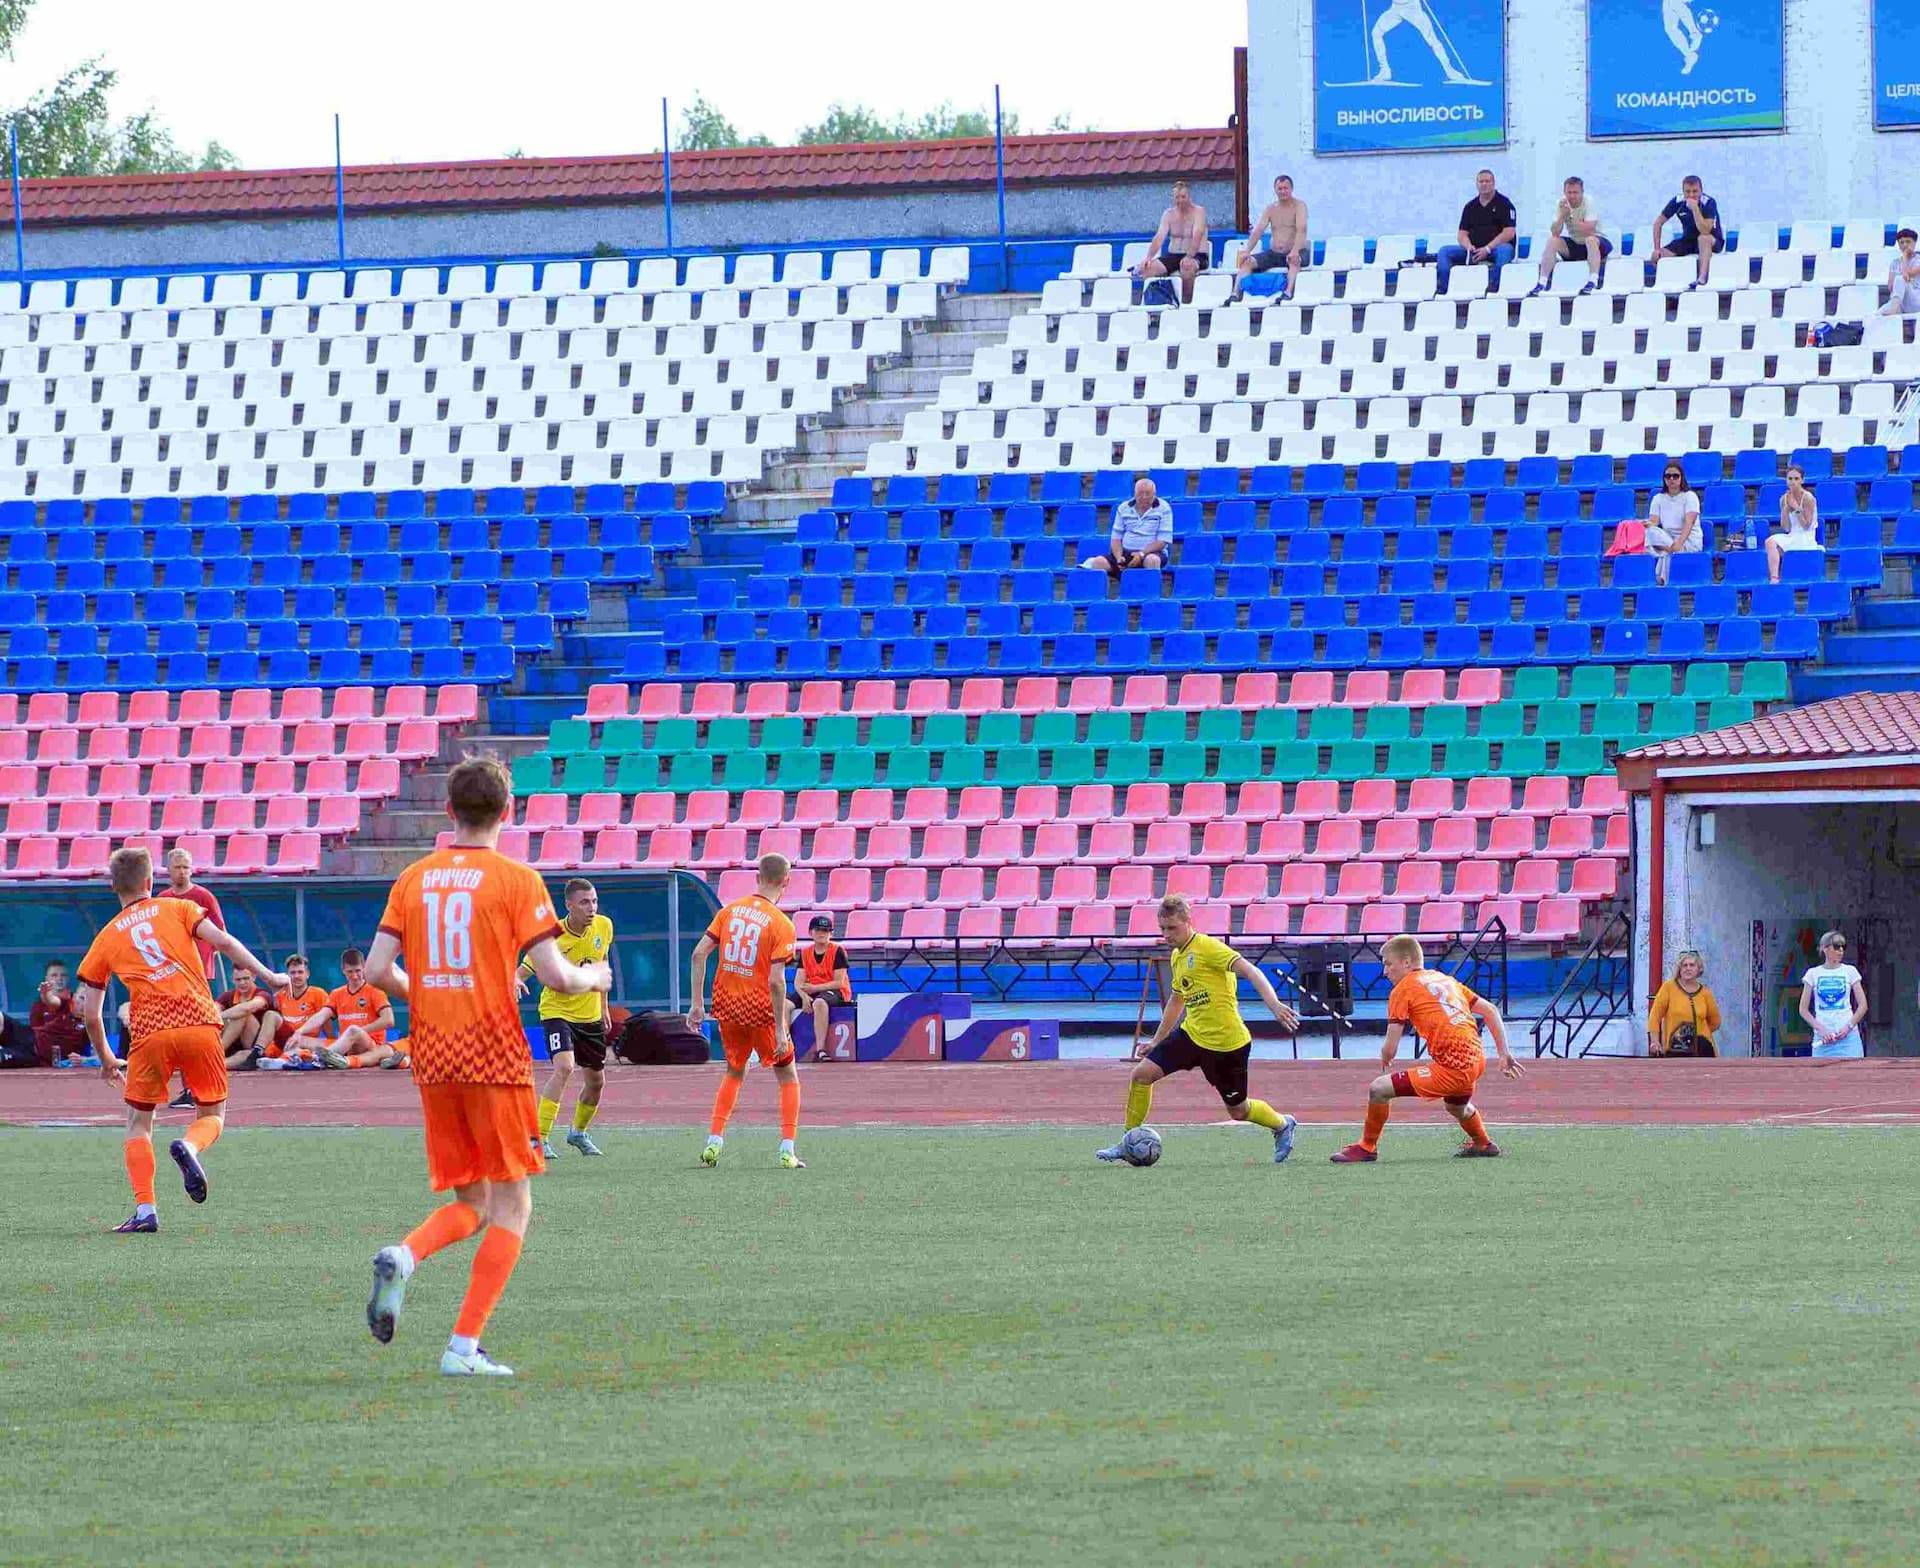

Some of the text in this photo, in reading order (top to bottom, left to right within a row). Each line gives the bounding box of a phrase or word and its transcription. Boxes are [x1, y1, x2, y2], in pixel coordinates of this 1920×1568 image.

[1337, 104, 1484, 126] ВЫНОСЛИВОСТЬ
[1616, 88, 1757, 109] КОМАНДНОСТЬ
[130, 921, 168, 968] 6
[422, 891, 473, 970] 18
[724, 917, 761, 967] 33
[549, 1032, 561, 1051] 18
[835, 1023, 850, 1057] 2
[925, 1019, 936, 1055] 1
[1010, 1031, 1026, 1059] 3
